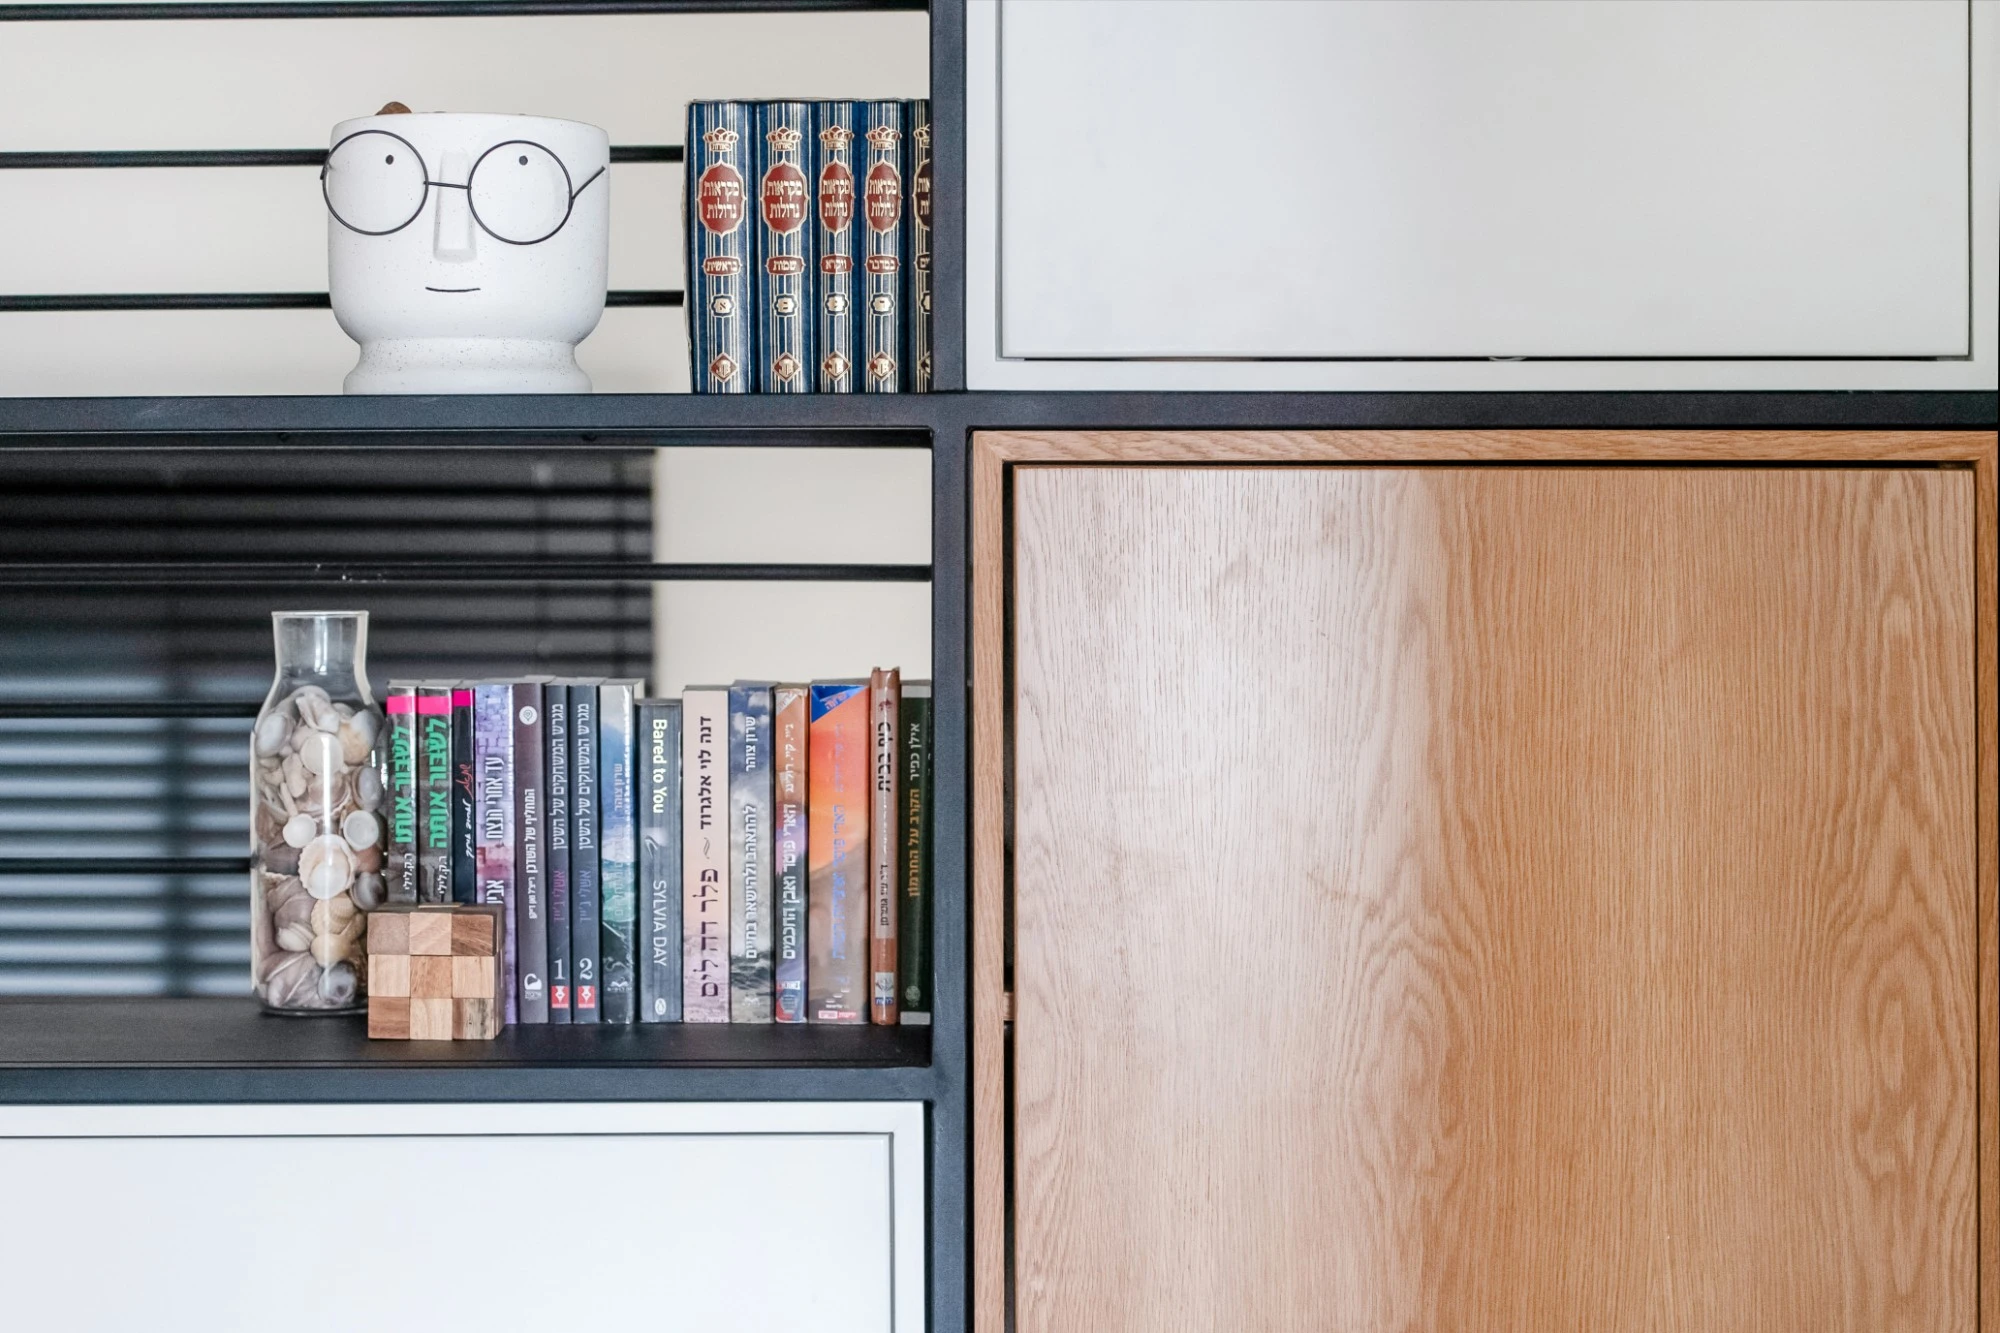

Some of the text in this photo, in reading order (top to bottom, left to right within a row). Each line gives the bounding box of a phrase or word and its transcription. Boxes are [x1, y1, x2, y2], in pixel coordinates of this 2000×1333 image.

[704, 181, 739, 202] מקראות
[767, 181, 803, 201] מקראות
[823, 179, 850, 200] מקראות
[869, 179, 897, 200] מקראות
[707, 197, 737, 219] גדולות
[770, 197, 800, 219] גדולות
[825, 196, 848, 217] גדולות
[871, 196, 894, 217] גדולות
[706, 261, 737, 272] בראשית
[773, 260, 797, 271] שמות
[825, 259, 846, 270] ויקרא
[869, 260, 896, 270] במדבר
[745, 716, 758, 772] שרון צוהר
[909, 723, 922, 781] אילן כפיר
[550, 704, 567, 849] מגרש המשחקים של השטן
[575, 704, 593, 849] מגרש המשחקים של השטן
[653, 719, 667, 814] Bared to You
[698, 716, 712, 829] דנה לוי אלגרוד
[784, 763, 794, 792] רולינג
[392, 725, 413, 843] לשבור אותו
[426, 718, 448, 849] לשבור אותה
[485, 756, 505, 839] עד אחרי הנצח
[524, 788, 537, 873] המחליף של השדכן
[832, 804, 844, 834] הארי
[908, 788, 921, 897] הקרב על החרמון
[552, 870, 565, 898] אשלי
[578, 870, 591, 898] אשלי
[742, 804, 757, 958] להתאהב ולהישאר בחיים
[782, 803, 800, 959] הארי פוטר ואבן החכמים
[653, 880, 667, 967] SYLVIA DAY
[693, 869, 718, 997] פלר דה לים
[554, 958, 565, 980] 1
[579, 958, 593, 980] 2
